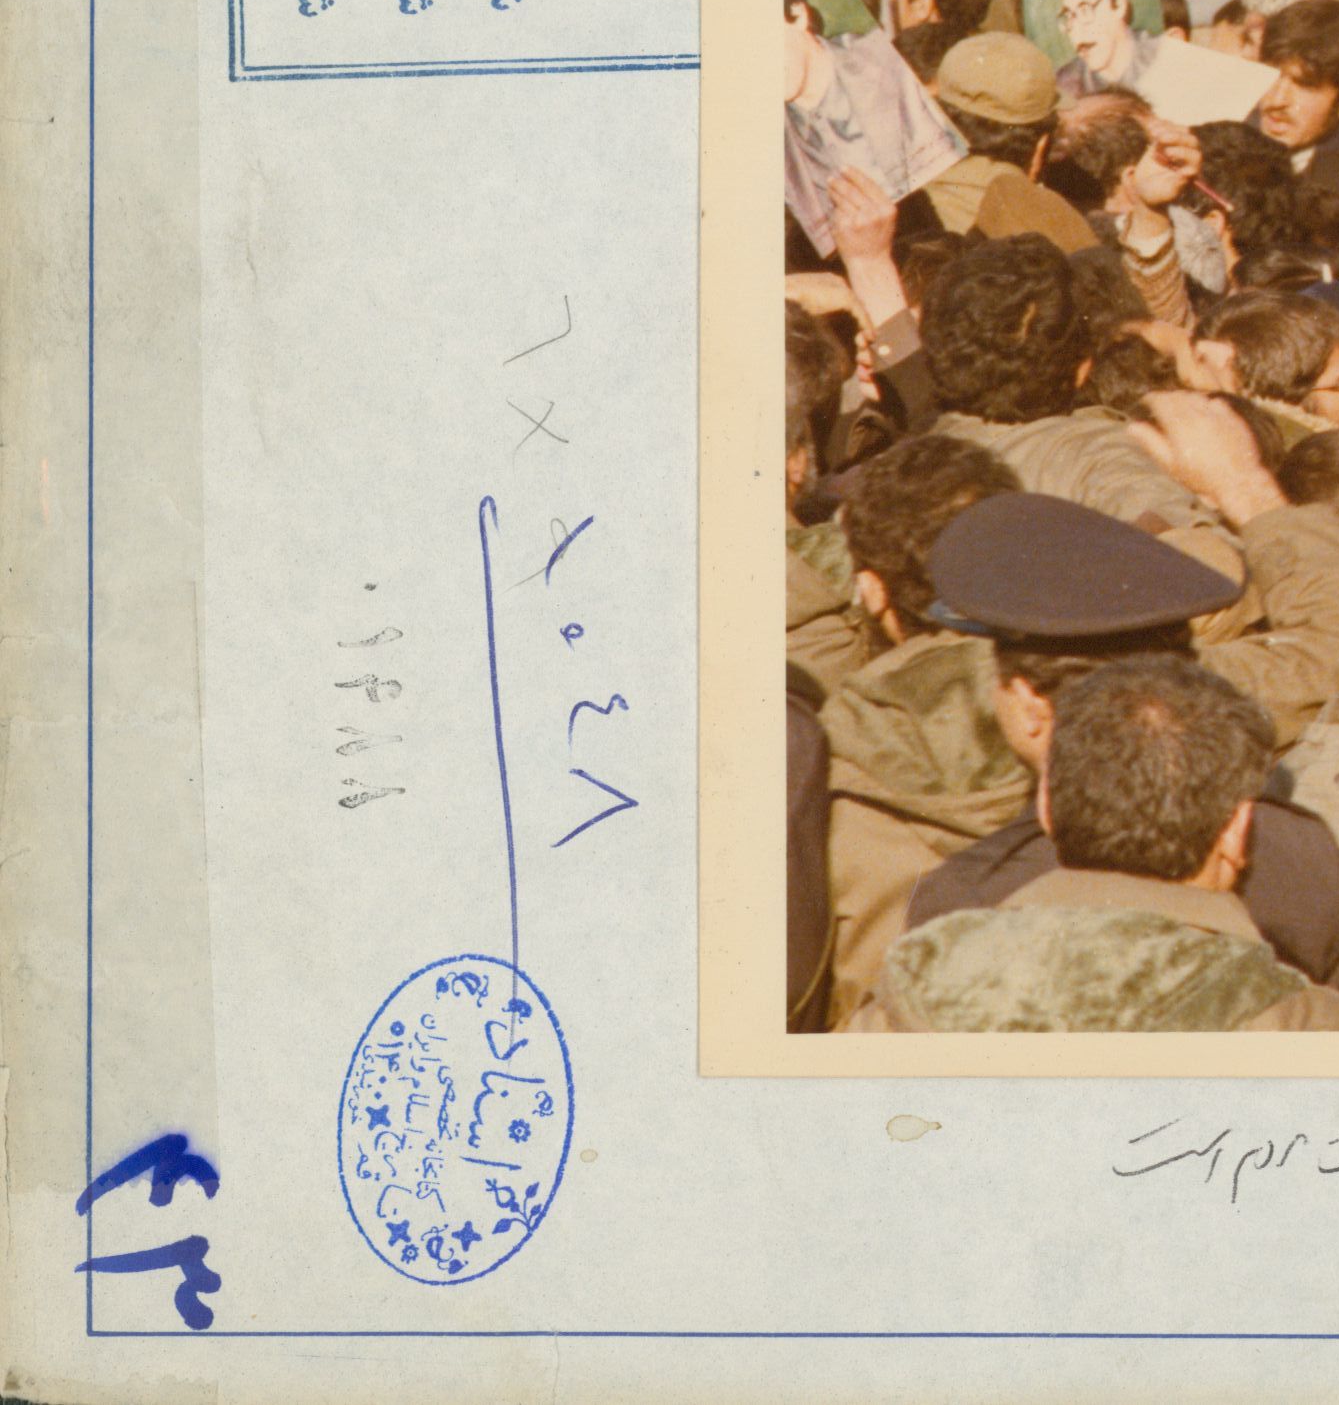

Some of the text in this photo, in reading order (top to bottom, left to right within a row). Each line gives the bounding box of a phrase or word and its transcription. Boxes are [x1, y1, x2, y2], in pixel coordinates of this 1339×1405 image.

[409, 1013, 448, 1062] ایران
[350, 1045, 377, 1125] خورشیدی
[398, 1077, 429, 1133] اسلام
[459, 1021, 546, 1170] اسناد
[357, 1144, 379, 1180] قم
[374, 1131, 412, 1218] تاریخ
[415, 1066, 460, 1212] کتابخانه تخصصی
